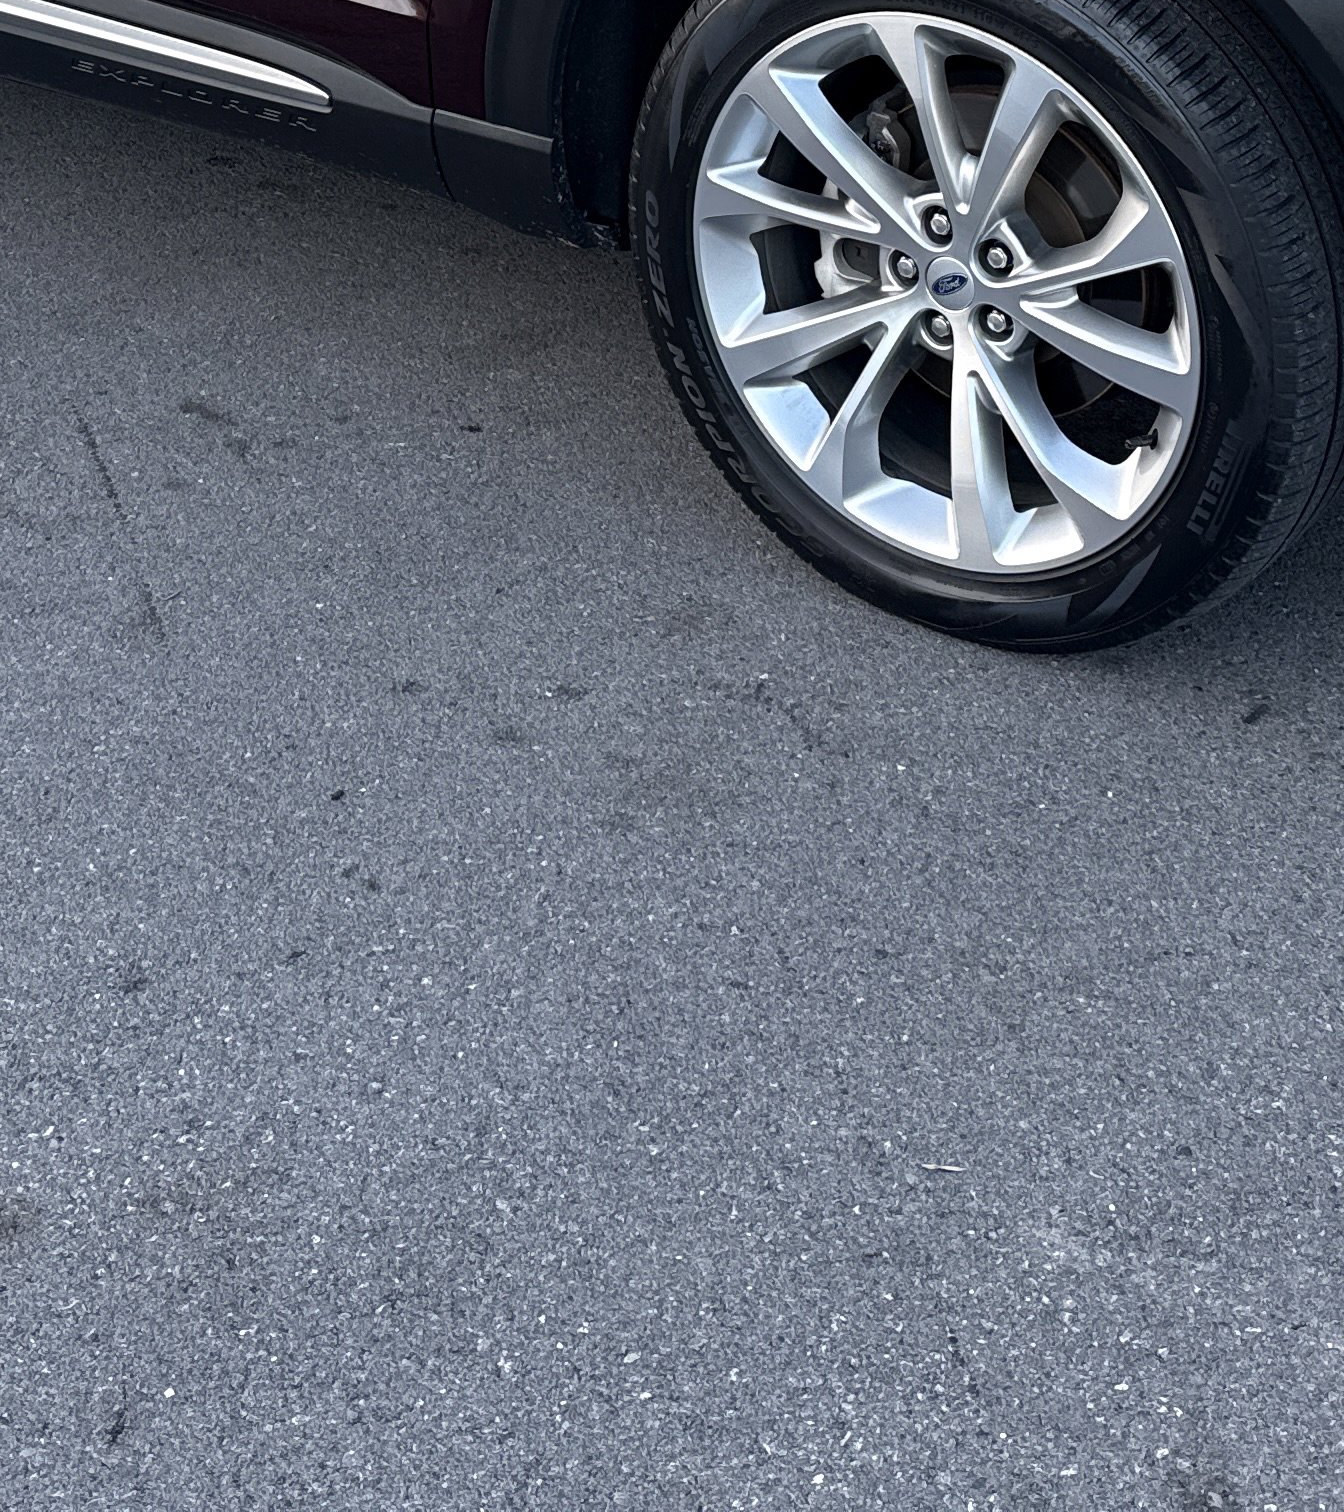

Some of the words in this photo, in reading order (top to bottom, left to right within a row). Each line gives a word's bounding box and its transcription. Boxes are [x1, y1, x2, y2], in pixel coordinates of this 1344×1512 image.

[70, 56, 317, 133] EXPLORER
[644, 189, 675, 329] ZERO
[937, 275, 965, 294] Ford
[666, 341, 834, 559] SCORPION
